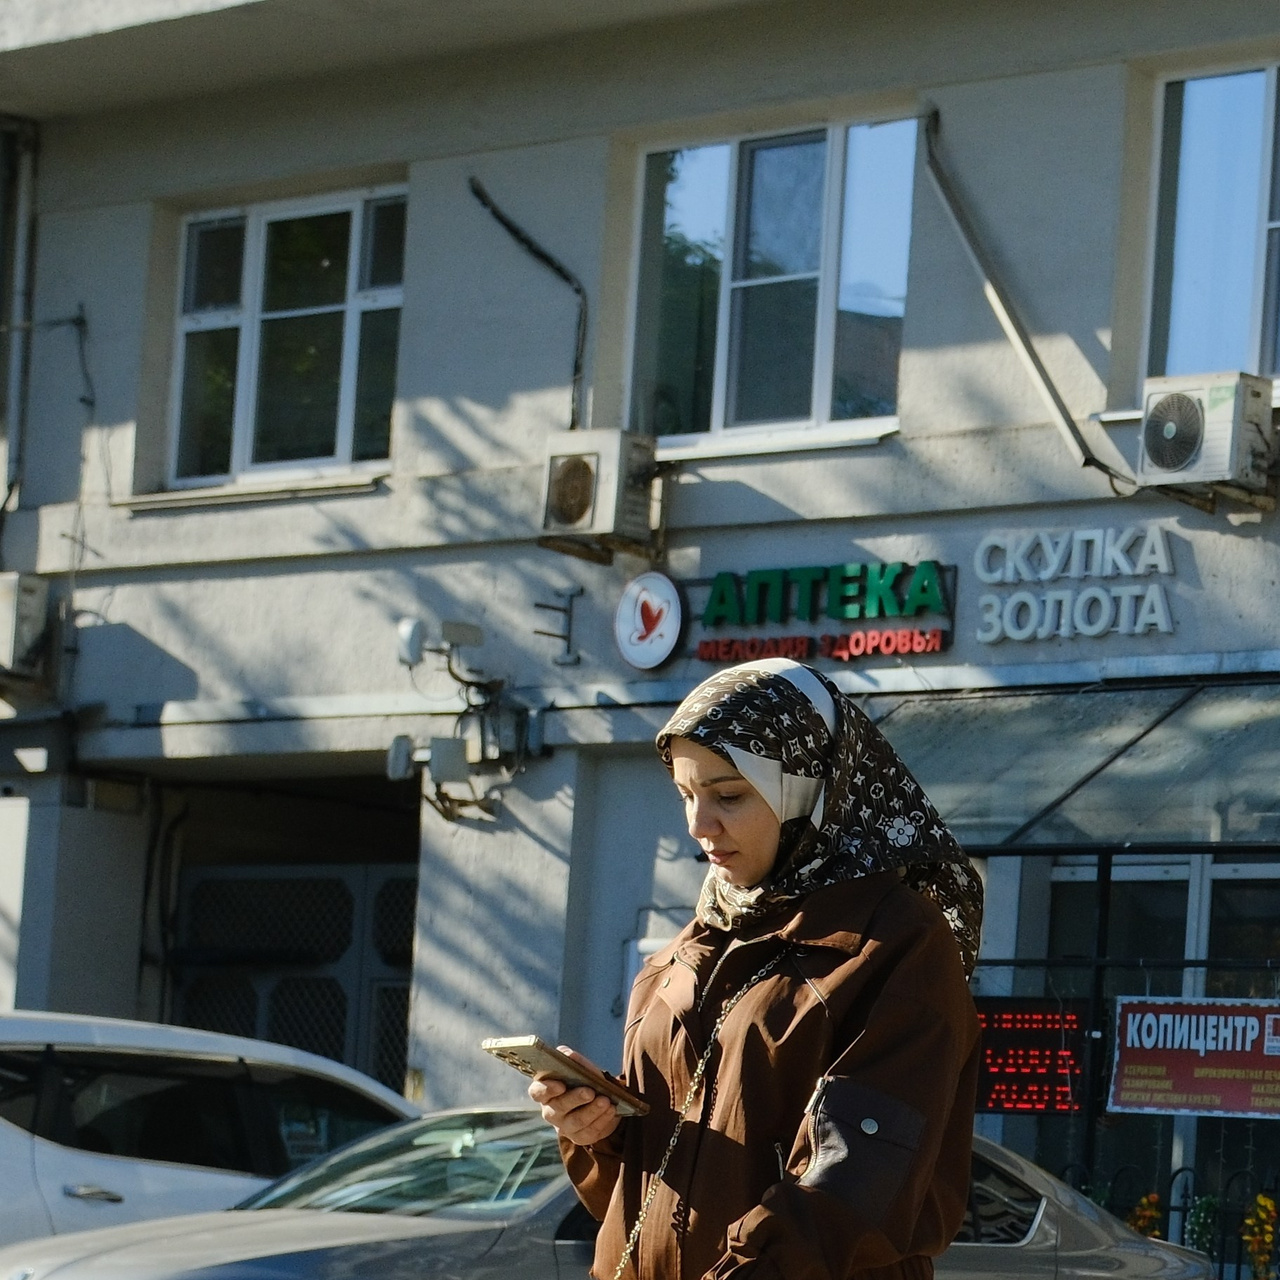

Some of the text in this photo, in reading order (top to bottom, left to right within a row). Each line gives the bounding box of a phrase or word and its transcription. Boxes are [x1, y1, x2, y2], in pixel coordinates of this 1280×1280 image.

[973, 526, 1175, 584] СКУПКА
[701, 561, 946, 626] АПТЕКА
[976, 583, 1175, 645] ЗОЛОТА
[698, 629, 942, 662] МЕЛОДИЯ ЗДОРОВЬЯ
[1126, 1012, 1261, 1057] КОПИЦЕНТР
